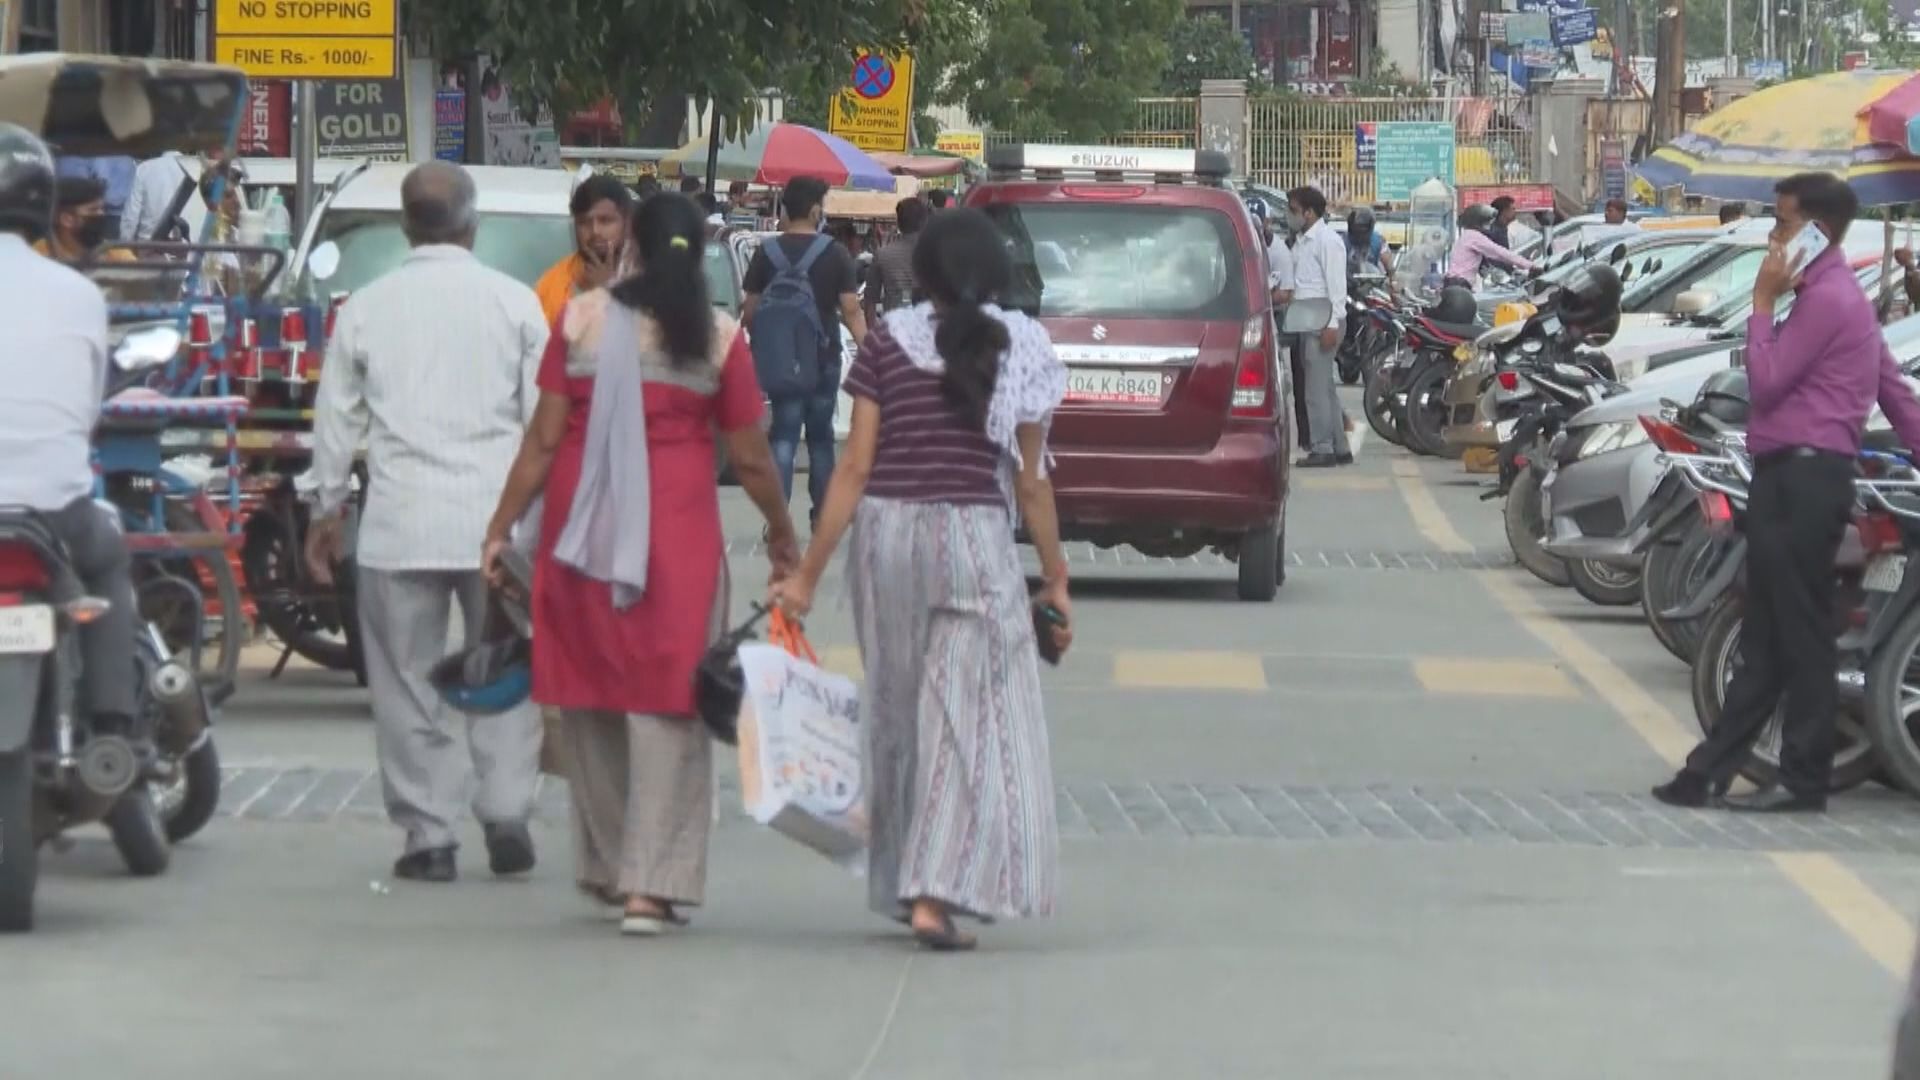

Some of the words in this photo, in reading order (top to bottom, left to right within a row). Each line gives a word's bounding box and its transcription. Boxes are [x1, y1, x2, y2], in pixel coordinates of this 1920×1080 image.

[239, 2, 266, 18] NO
[275, 2, 371, 18] STOPPING
[233, 49, 274, 64] FINE
[323, 49, 374, 64] 1000/-
[336, 83, 383, 106] FOR
[860, 105, 899, 116] PARKING
[321, 112, 402, 140] GOLD
[856, 119, 898, 128] STOPPING
[1083, 153, 1139, 168] SUZUKI
[1102, 376, 1112, 393] K
[1117, 377, 1157, 395] 6849
